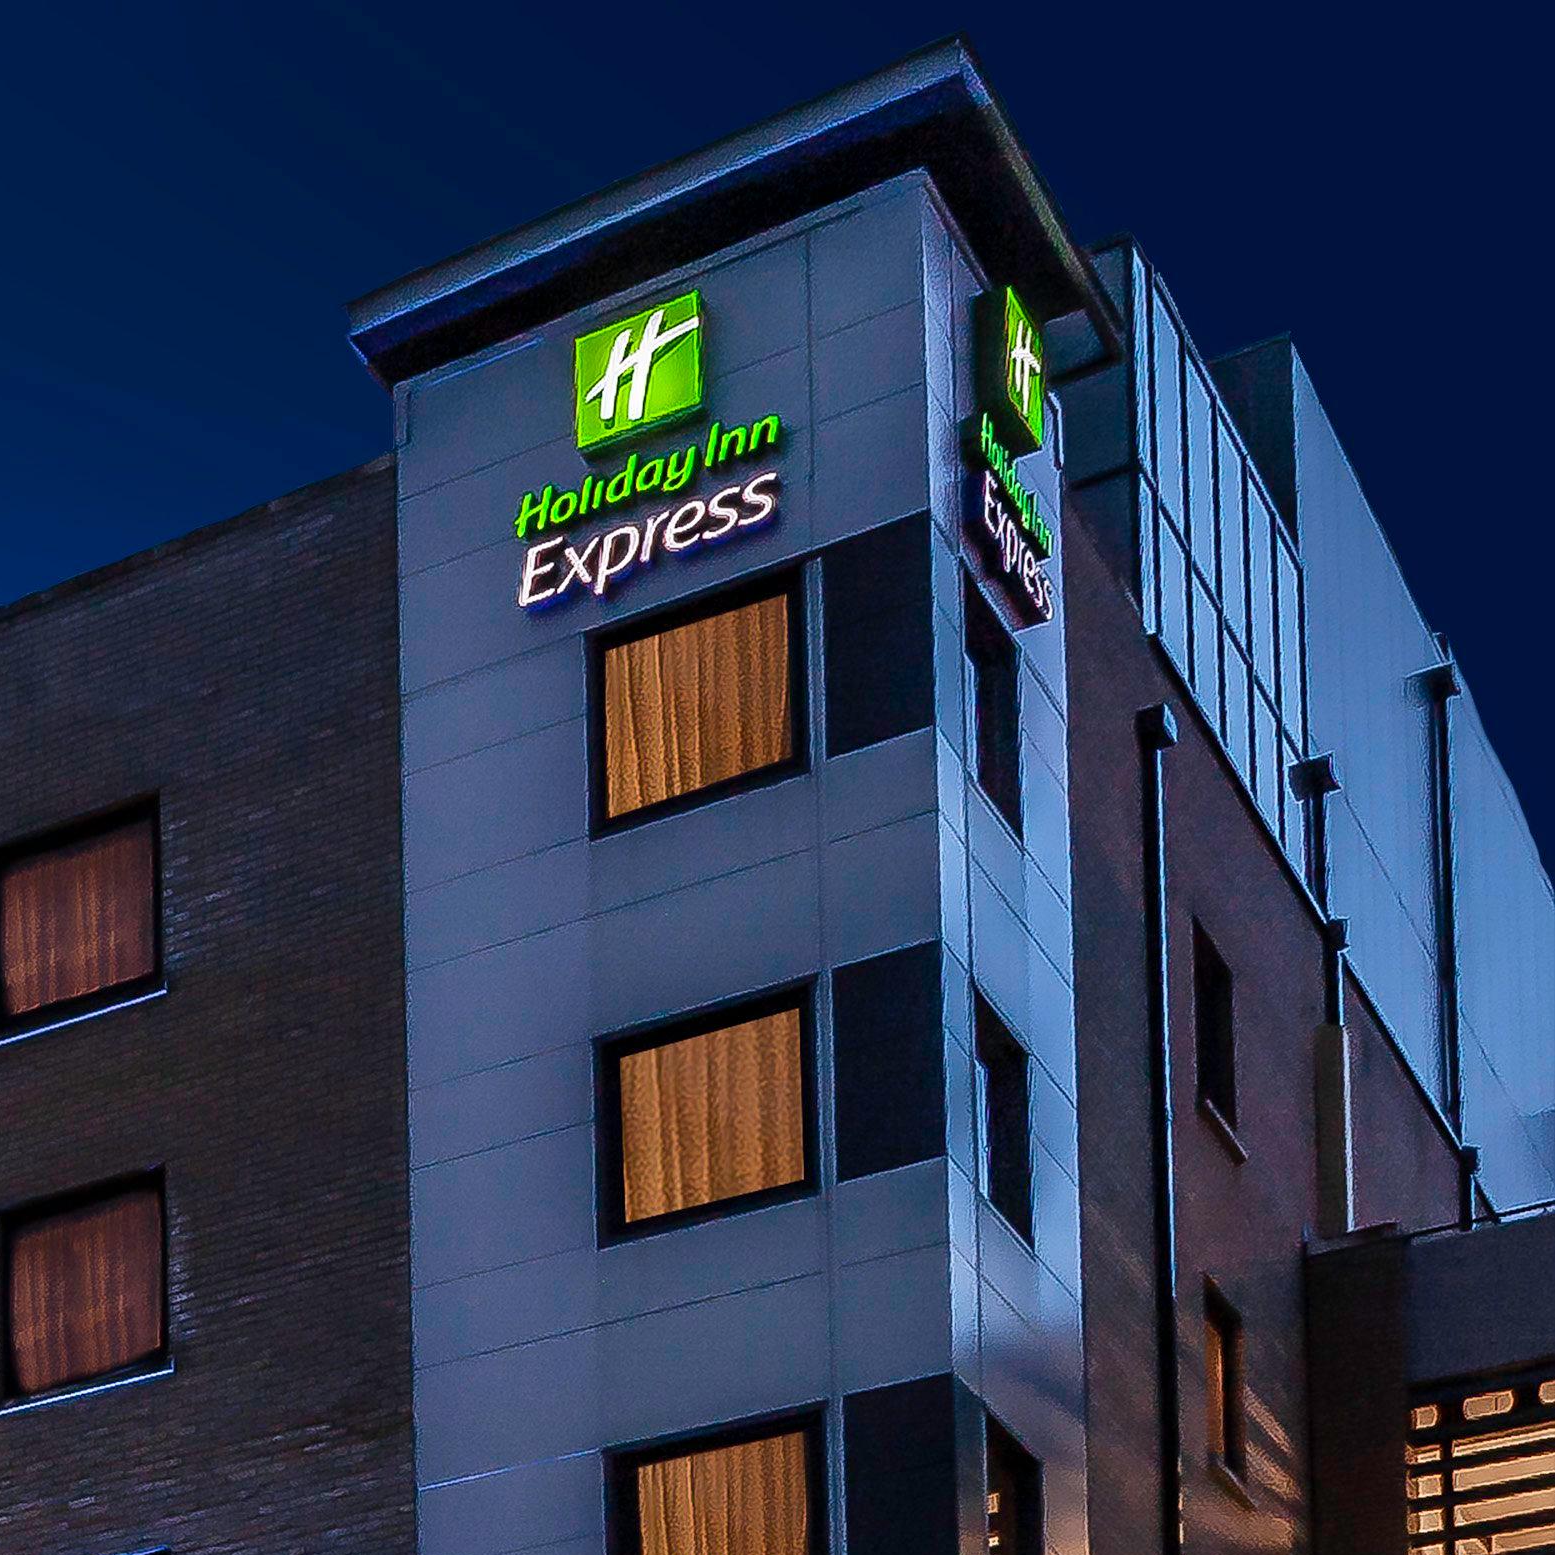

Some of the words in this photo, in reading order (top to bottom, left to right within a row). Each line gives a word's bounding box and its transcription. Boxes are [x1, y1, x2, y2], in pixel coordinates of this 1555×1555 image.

[584, 308, 700, 421] H
[514, 446, 696, 538] Holiday
[705, 415, 779, 467] Inn
[518, 472, 777, 607] Express
[981, 412, 1032, 530] Holiday
[1032, 489, 1052, 556] Inn
[984, 469, 1053, 620] Express
